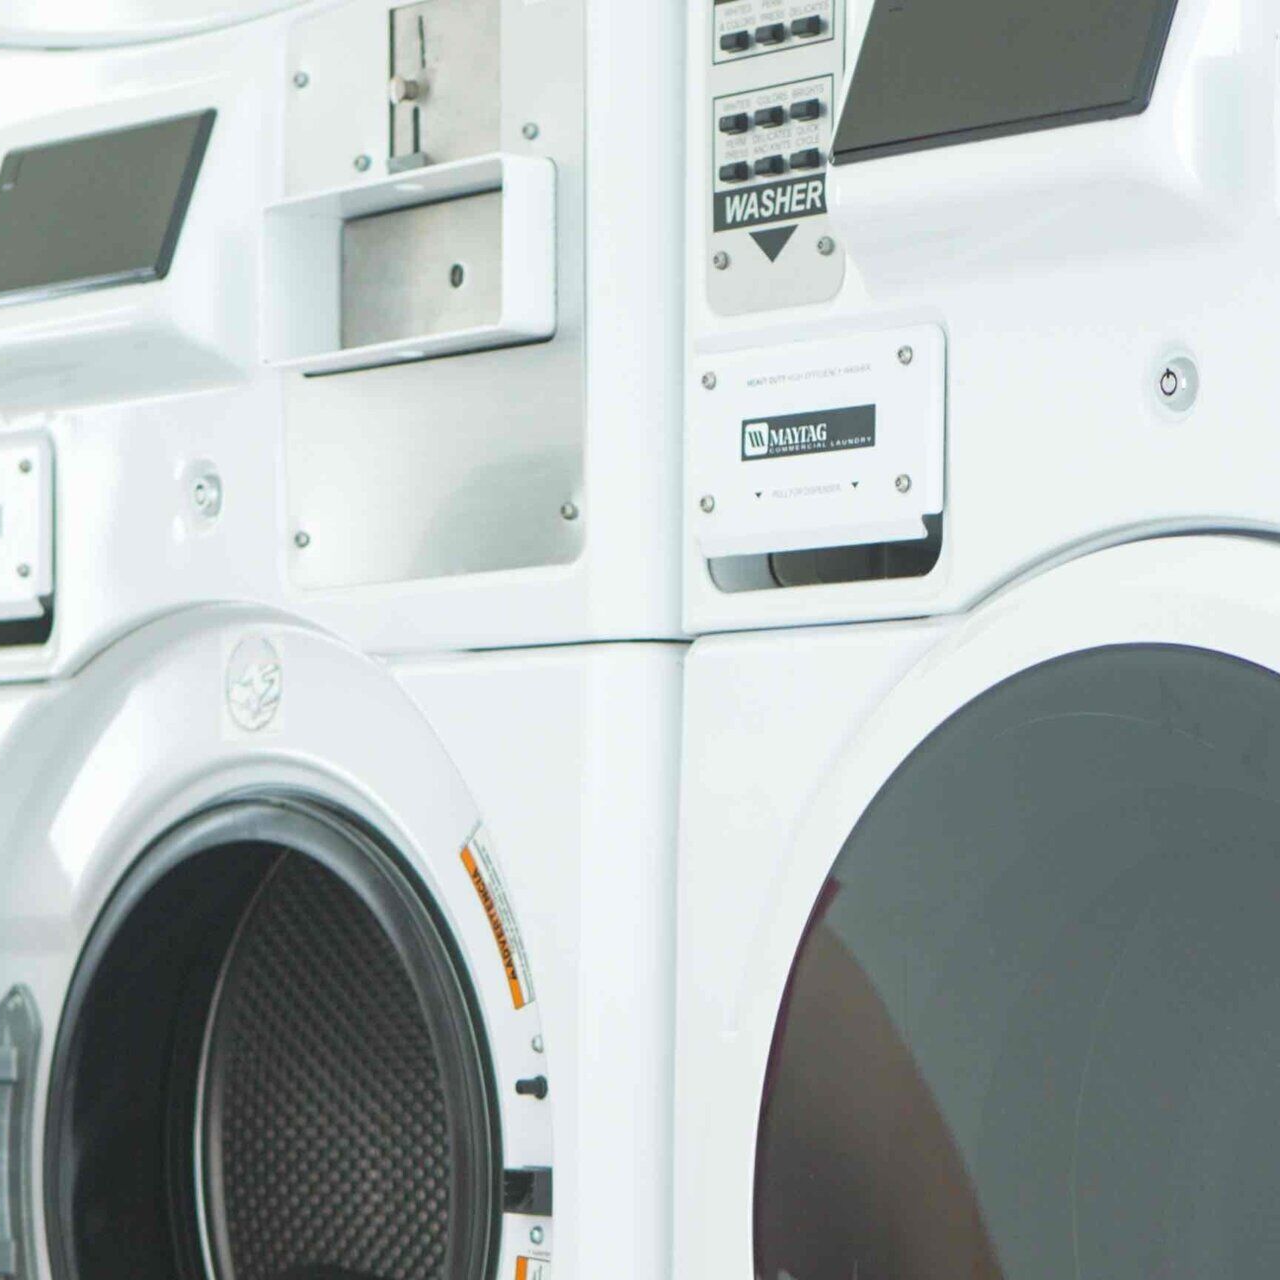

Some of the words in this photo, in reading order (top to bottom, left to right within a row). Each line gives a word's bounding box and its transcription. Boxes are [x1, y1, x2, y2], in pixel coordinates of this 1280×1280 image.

[725, 180, 823, 224] WASHER
[769, 442, 827, 454] COMMERCIAL
[830, 436, 872, 447] LAUNDRY
[770, 423, 827, 447] MAYTAG
